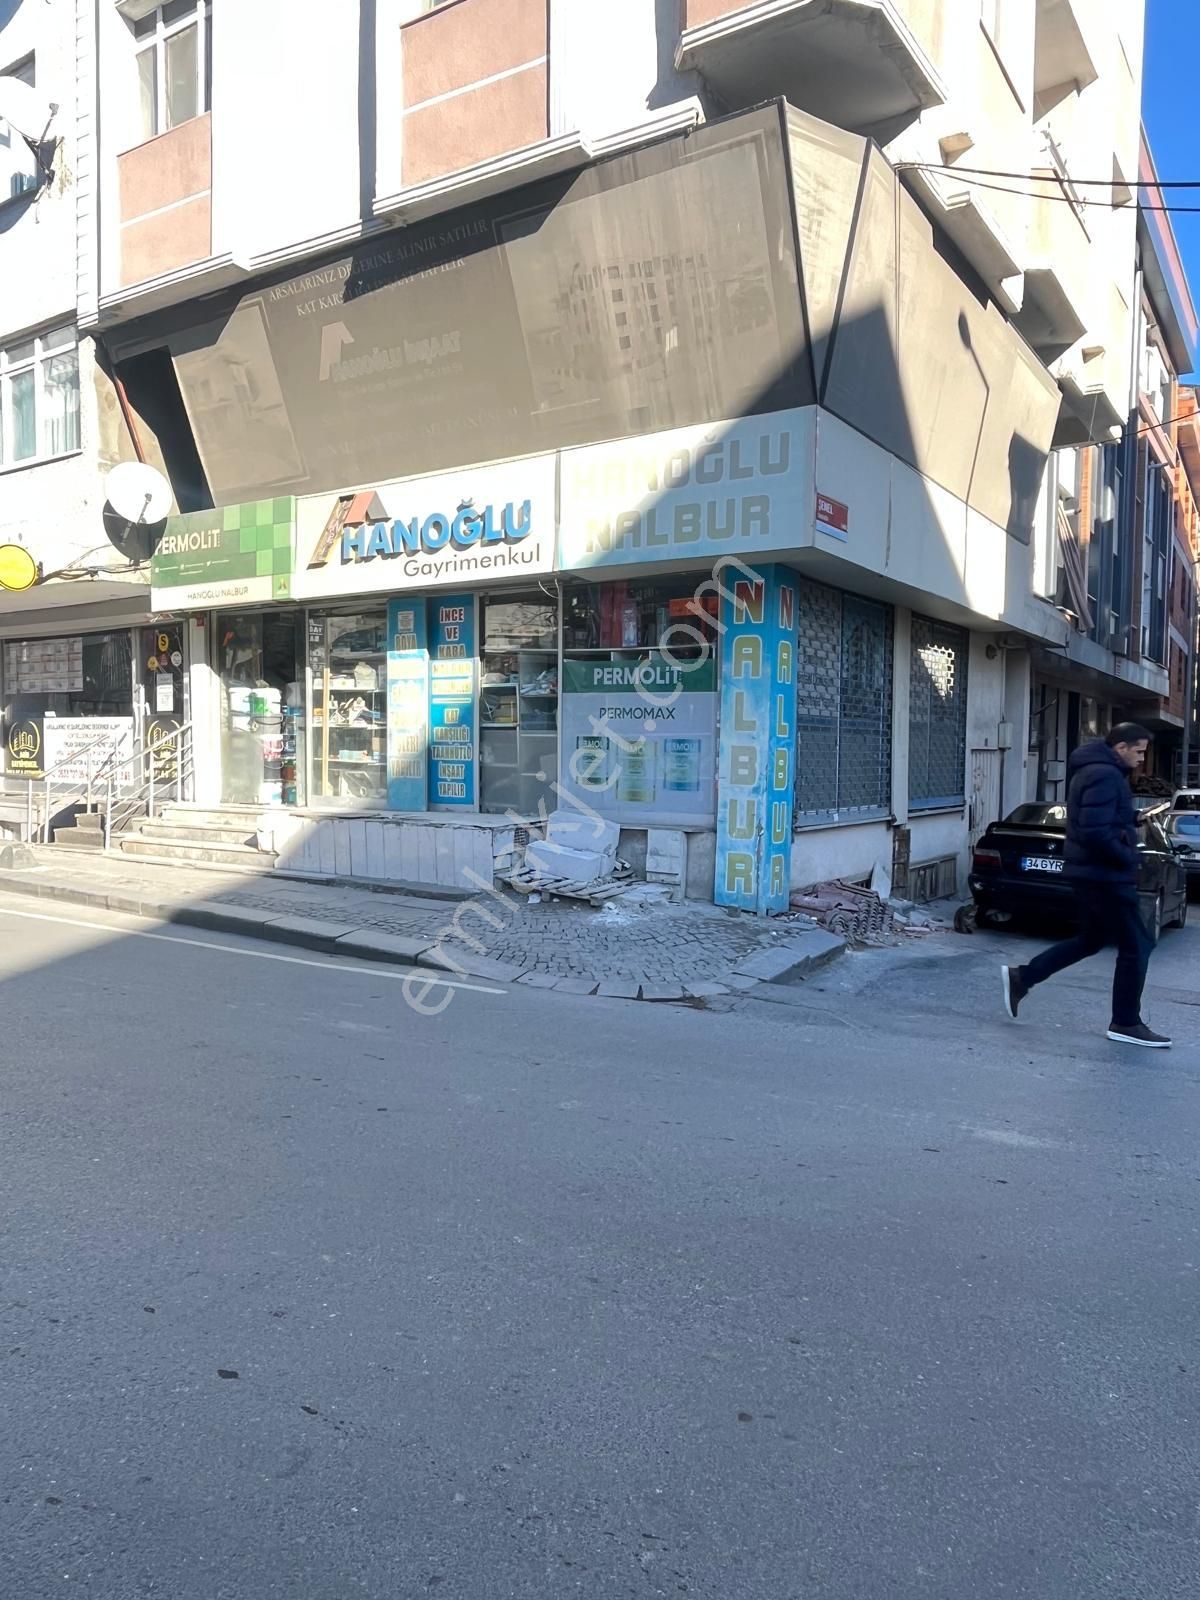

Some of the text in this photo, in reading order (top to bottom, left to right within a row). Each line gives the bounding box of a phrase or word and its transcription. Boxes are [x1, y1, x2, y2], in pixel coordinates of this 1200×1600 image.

[296, 301, 317, 317] KAT
[574, 431, 791, 498] HANOĞLU
[342, 496, 532, 562] HANOĞLU
[585, 494, 771, 553] NALBUR
[403, 543, 541, 579] Gayrimenkul
[221, 585, 249, 599] NALBUR
[440, 606, 464, 623] İNCE
[446, 626, 459, 641] VE
[599, 707, 676, 721] PERMOMAX
[725, 579, 765, 896] NALBUR
[770, 585, 794, 897] NALBUR
[438, 781, 466, 798] YAPILIR
[1026, 858, 1063, 871] 34 GYR
